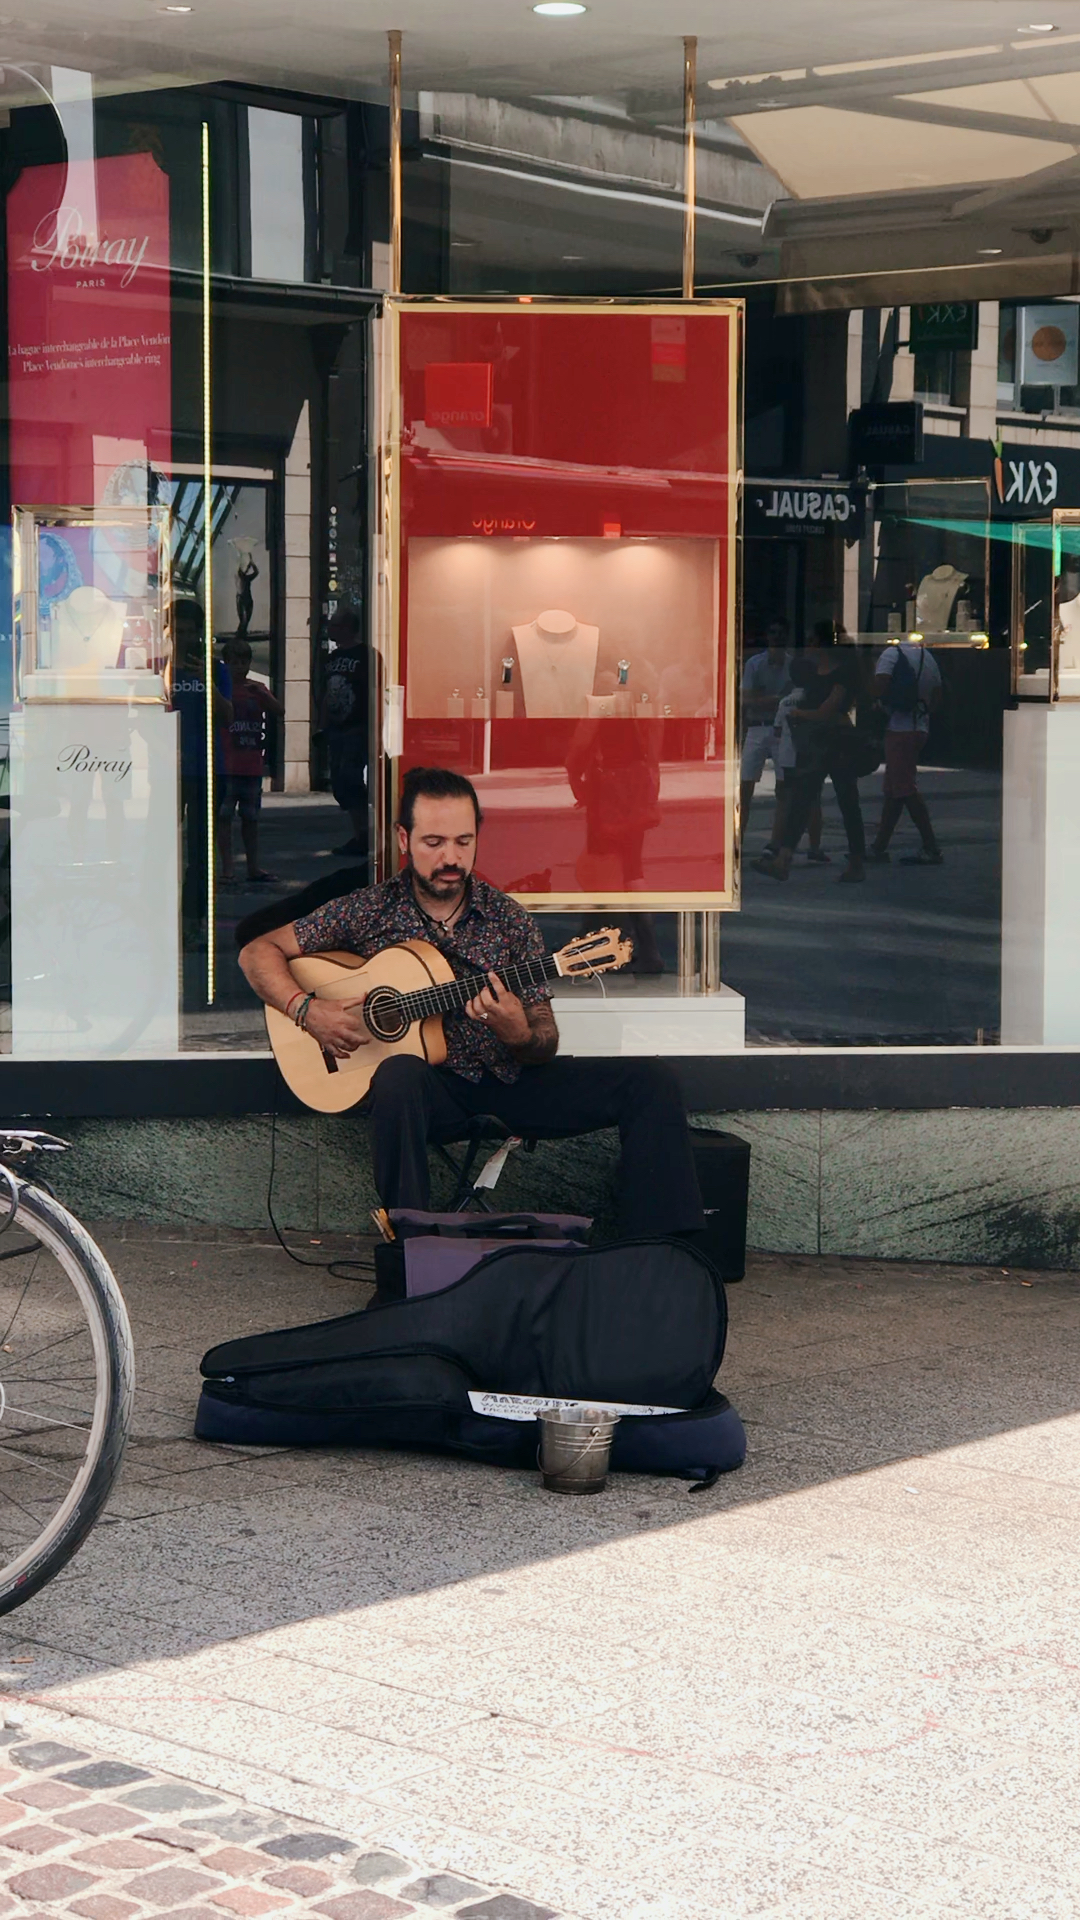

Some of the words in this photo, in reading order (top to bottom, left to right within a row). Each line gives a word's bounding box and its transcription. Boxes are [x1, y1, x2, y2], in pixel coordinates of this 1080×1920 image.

[31, 206, 149, 288] Poiray
[75, 278, 106, 289] PARIS
[42, 337, 100, 354] interchangeable
[100, 336, 110, 349] de
[110, 336, 118, 348] la
[118, 335, 140, 348] Place
[23, 360, 44, 373] Place
[84, 352, 144, 369] interchangeable
[144, 351, 161, 366] ring
[56, 744, 133, 783] Poiray
